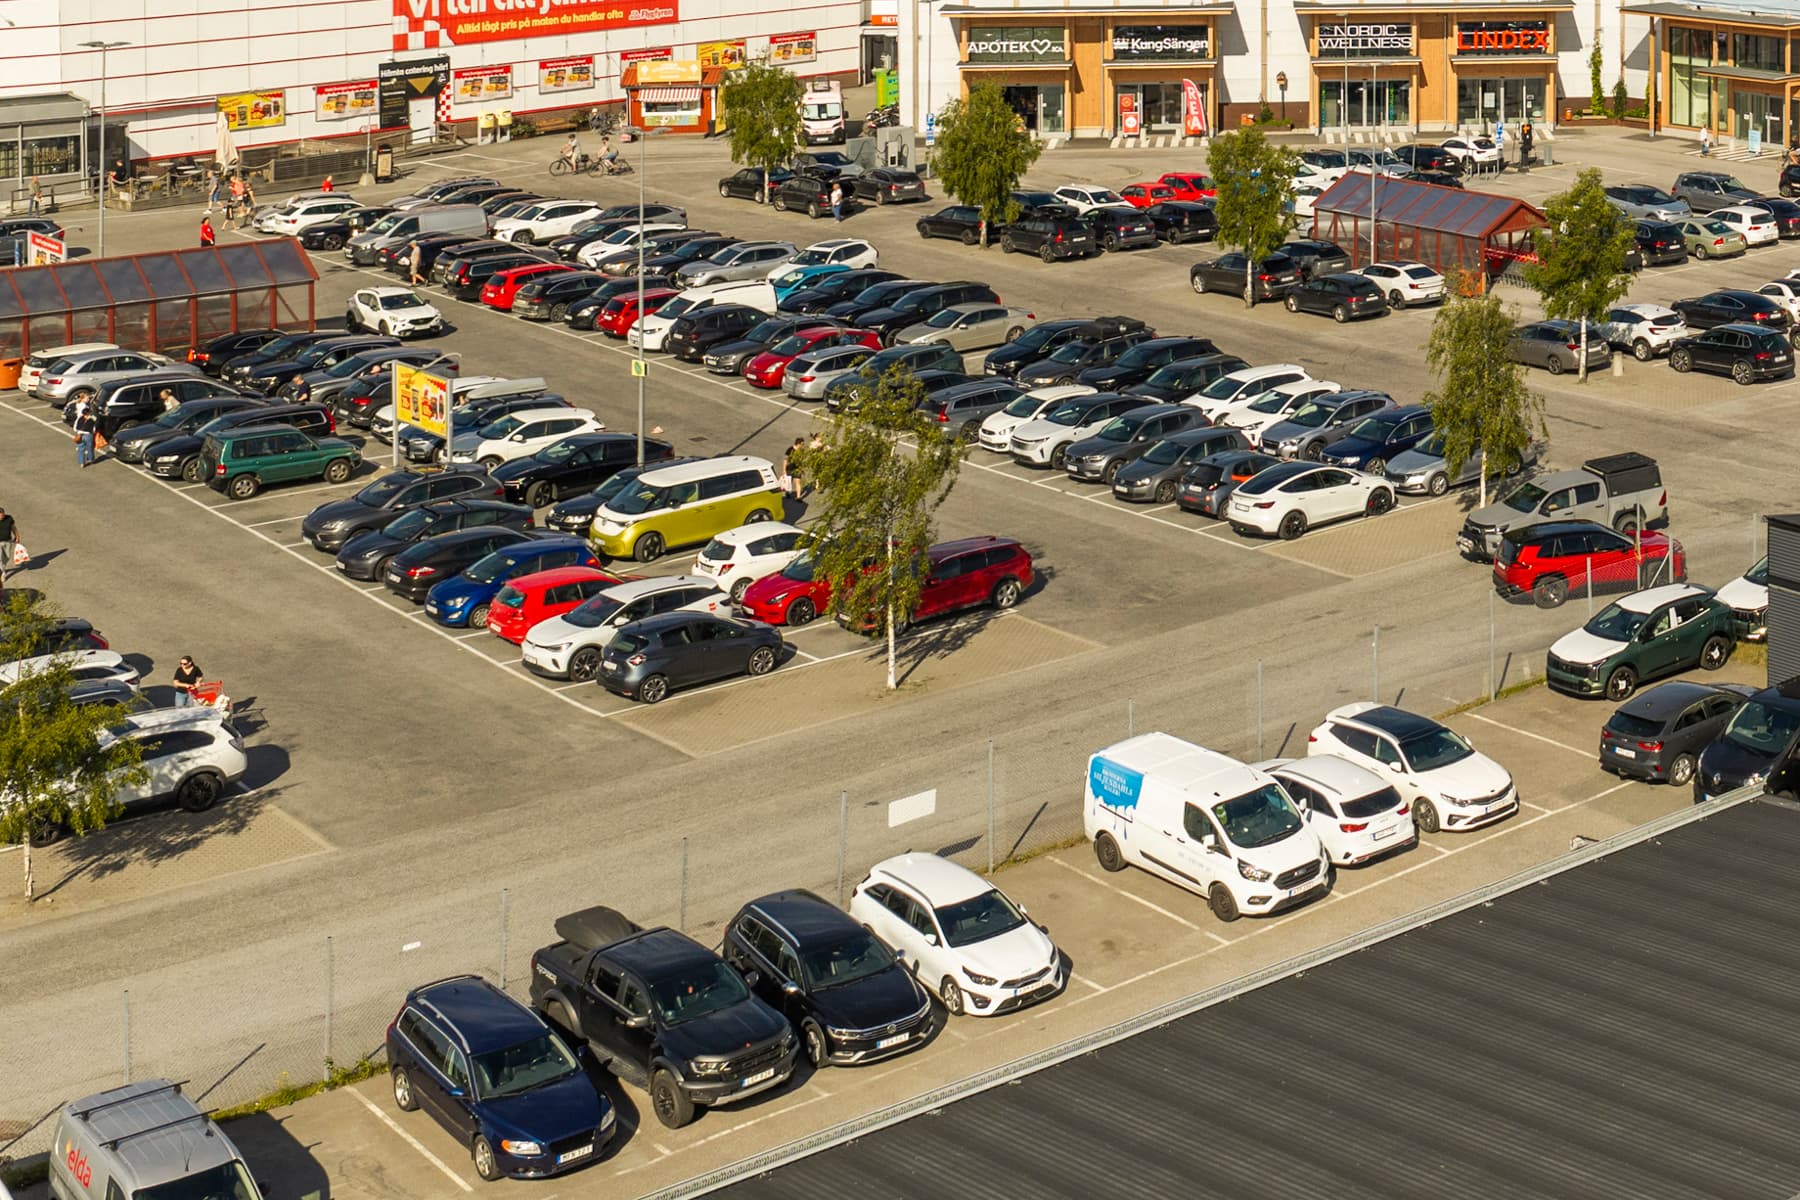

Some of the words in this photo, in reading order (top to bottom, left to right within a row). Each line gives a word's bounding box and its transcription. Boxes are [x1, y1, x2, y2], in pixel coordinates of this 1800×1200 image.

[456, 23, 481, 34] Alltid
[481, 20, 500, 33] lågt
[500, 19, 518, 31] pris
[518, 16, 530, 30] på
[531, 16, 559, 28] maten
[560, 13, 572, 24] du
[573, 11, 605, 23] handlar
[606, 9, 623, 20] ofta
[1334, 25, 1398, 36] NORDIC
[967, 41, 1030, 54] APOTEK
[1131, 38, 1208, 52] KungSängen
[1319, 37, 1412, 48] WELLNESS
[1458, 30, 1549, 50] LINDEX
[1187, 86, 1203, 130] REA
[67, 1147, 92, 1189] elda
